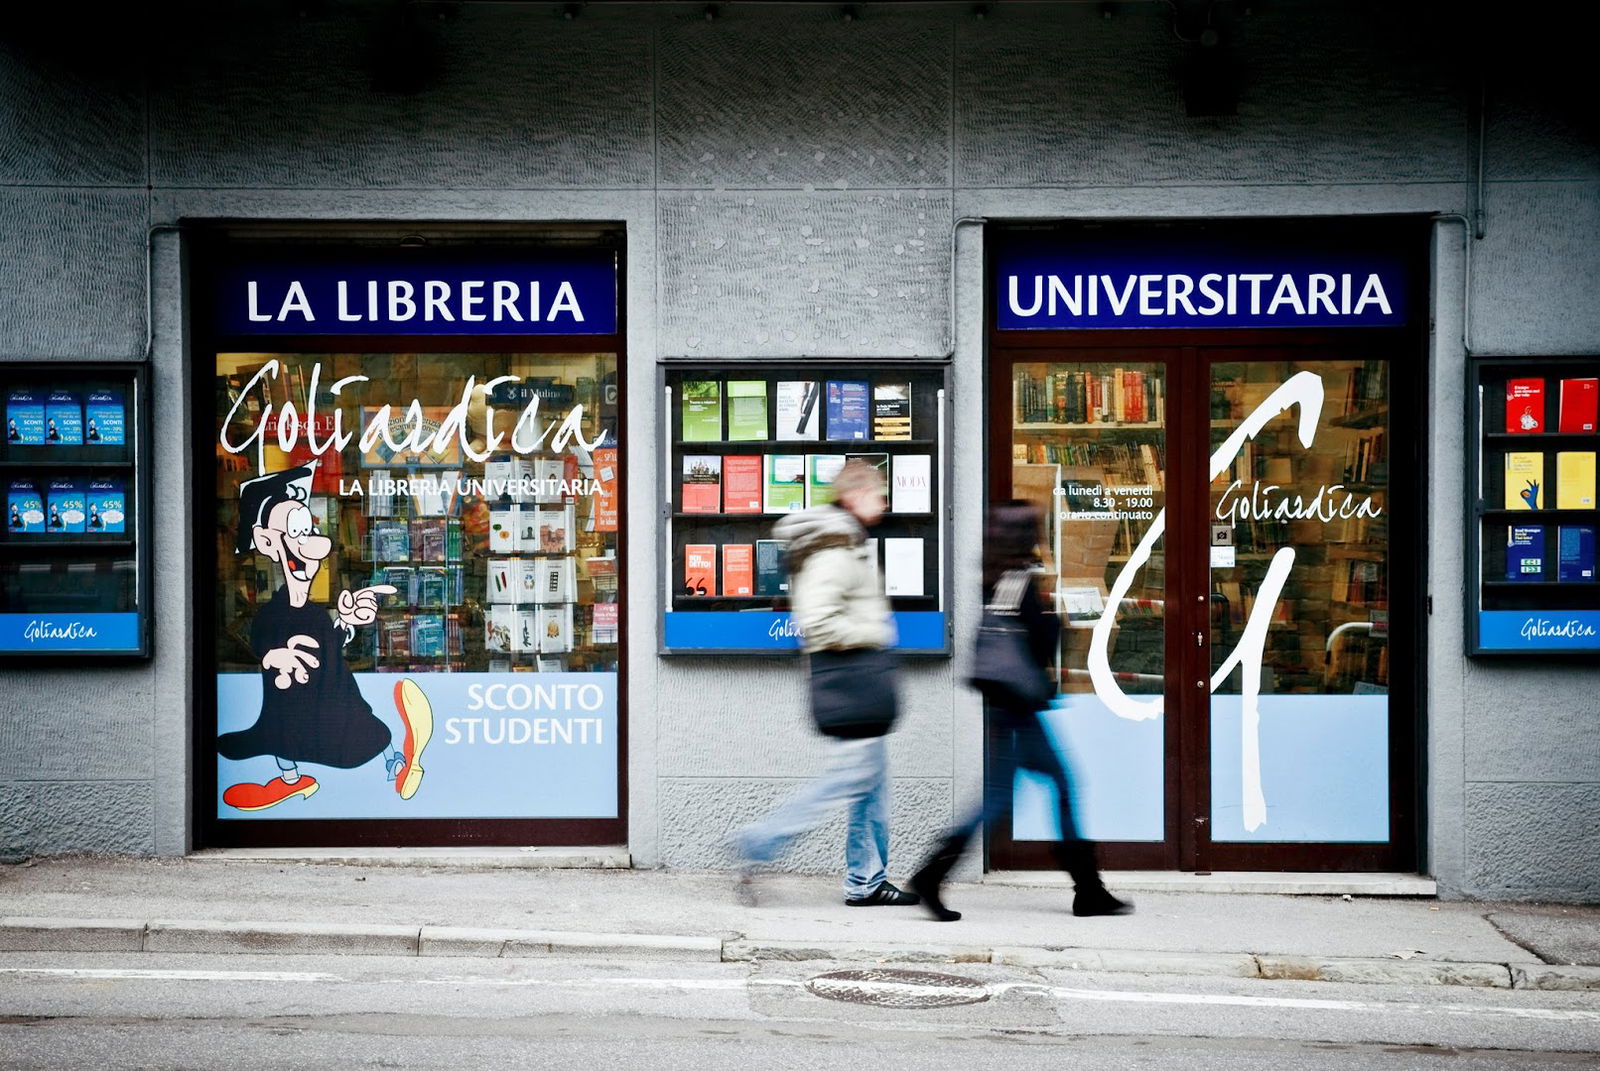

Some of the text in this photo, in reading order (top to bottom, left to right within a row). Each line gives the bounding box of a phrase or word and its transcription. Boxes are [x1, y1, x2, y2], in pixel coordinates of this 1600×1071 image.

[248, 280, 584, 322] LA LIBRERIA
[1007, 273, 1393, 317] UNIVERSITARIA
[219, 359, 609, 477] Goliardica
[339, 480, 364, 496] LA
[369, 480, 451, 496] LIBRERIA
[457, 479, 603, 496] UNIVERSITARIA
[1053, 485, 1066, 496] da
[1105, 488, 1111, 496] a
[63, 500, 83, 509] 45%
[102, 500, 122, 509] 45%
[1093, 498, 1115, 508] 8.30
[1126, 498, 1153, 508] 19.00
[1215, 480, 1382, 529] Goliardica
[1095, 509, 1153, 520] continuato
[25, 620, 97, 640] Goliardica
[1521, 618, 1596, 640] Goliardica
[468, 684, 604, 711] SCONTO
[445, 718, 602, 745] STUDENTI
